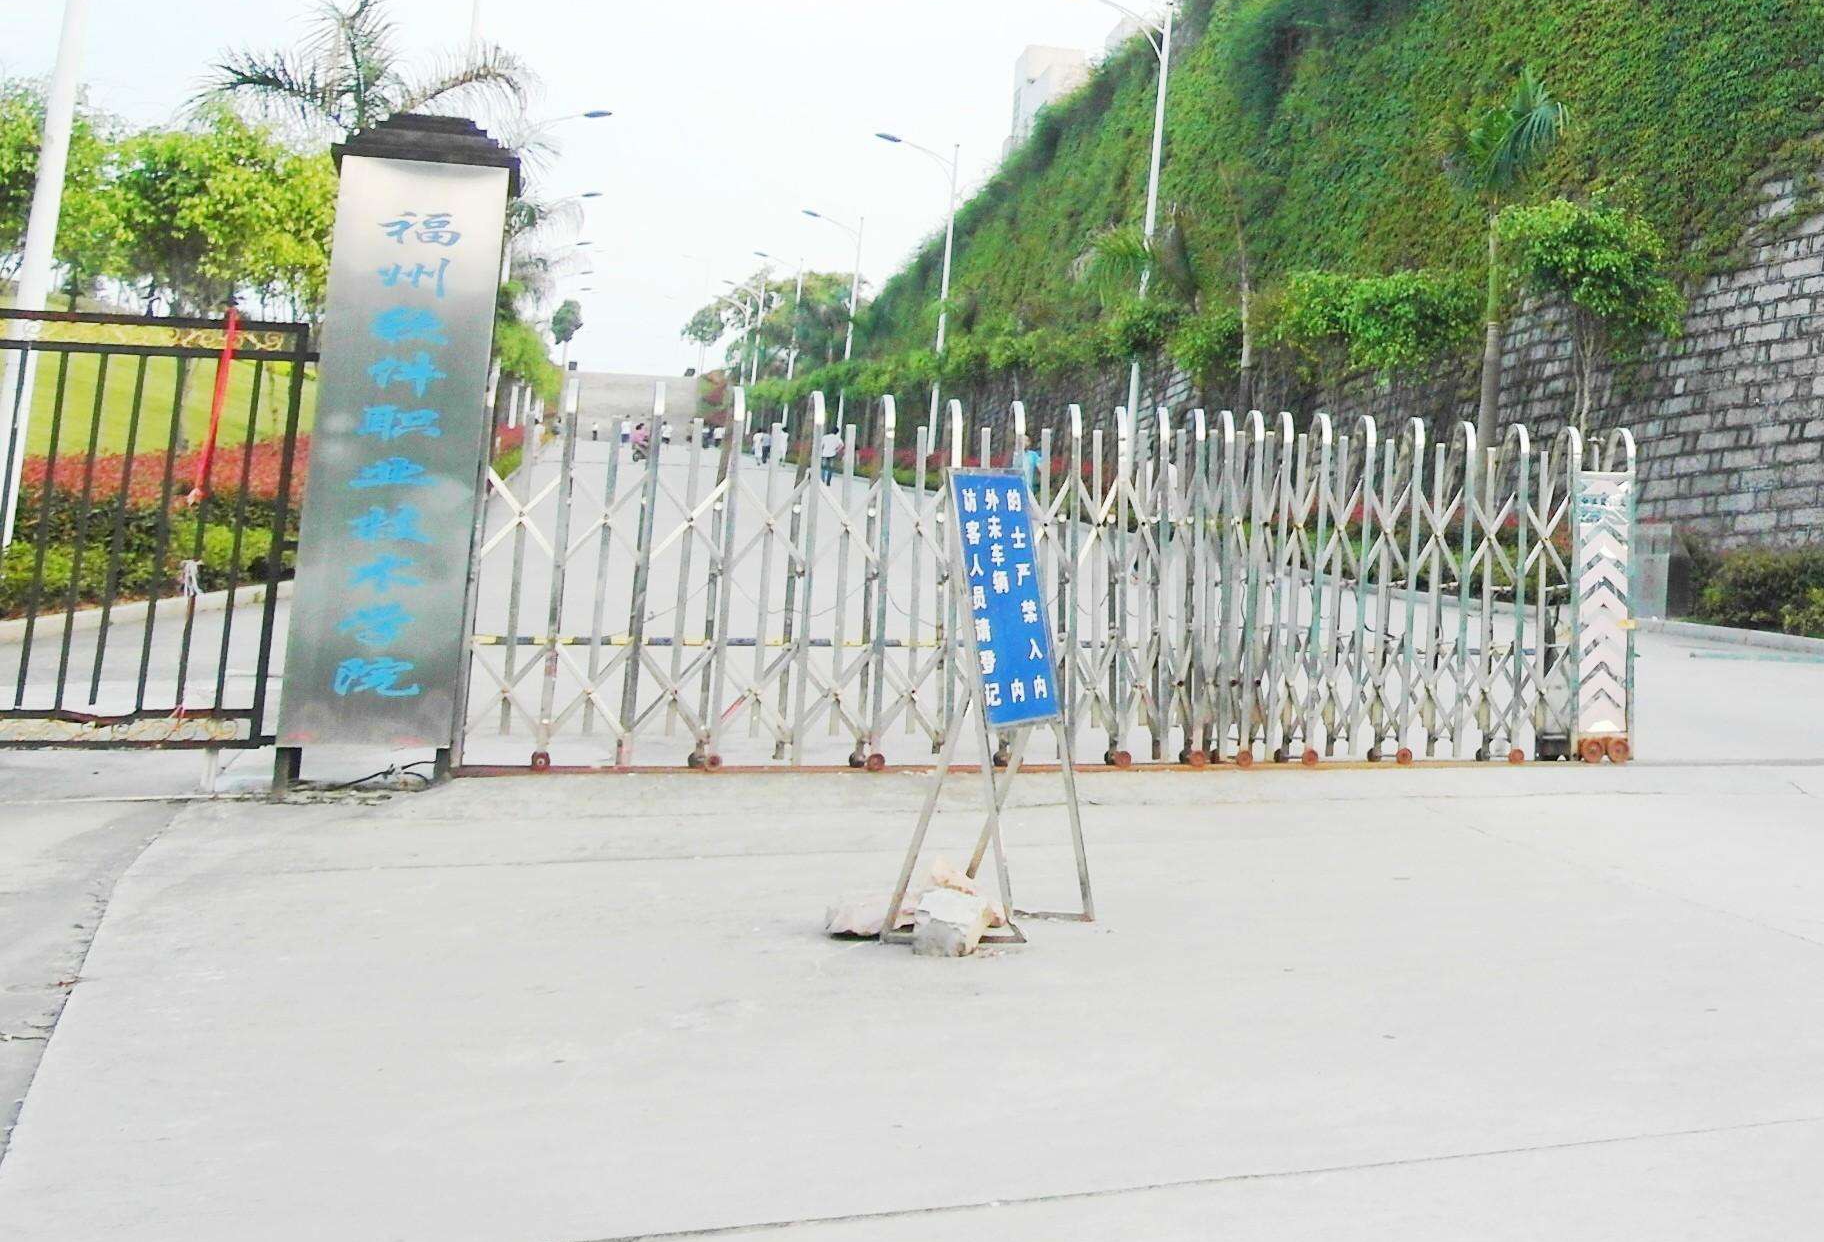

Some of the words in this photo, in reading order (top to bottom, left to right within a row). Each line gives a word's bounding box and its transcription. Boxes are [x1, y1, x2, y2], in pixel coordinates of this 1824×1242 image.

[961, 488, 1002, 707] 访客人员请登记
[984, 488, 1010, 594] 外来车辆
[1006, 489, 1048, 699] 的士严禁入内
